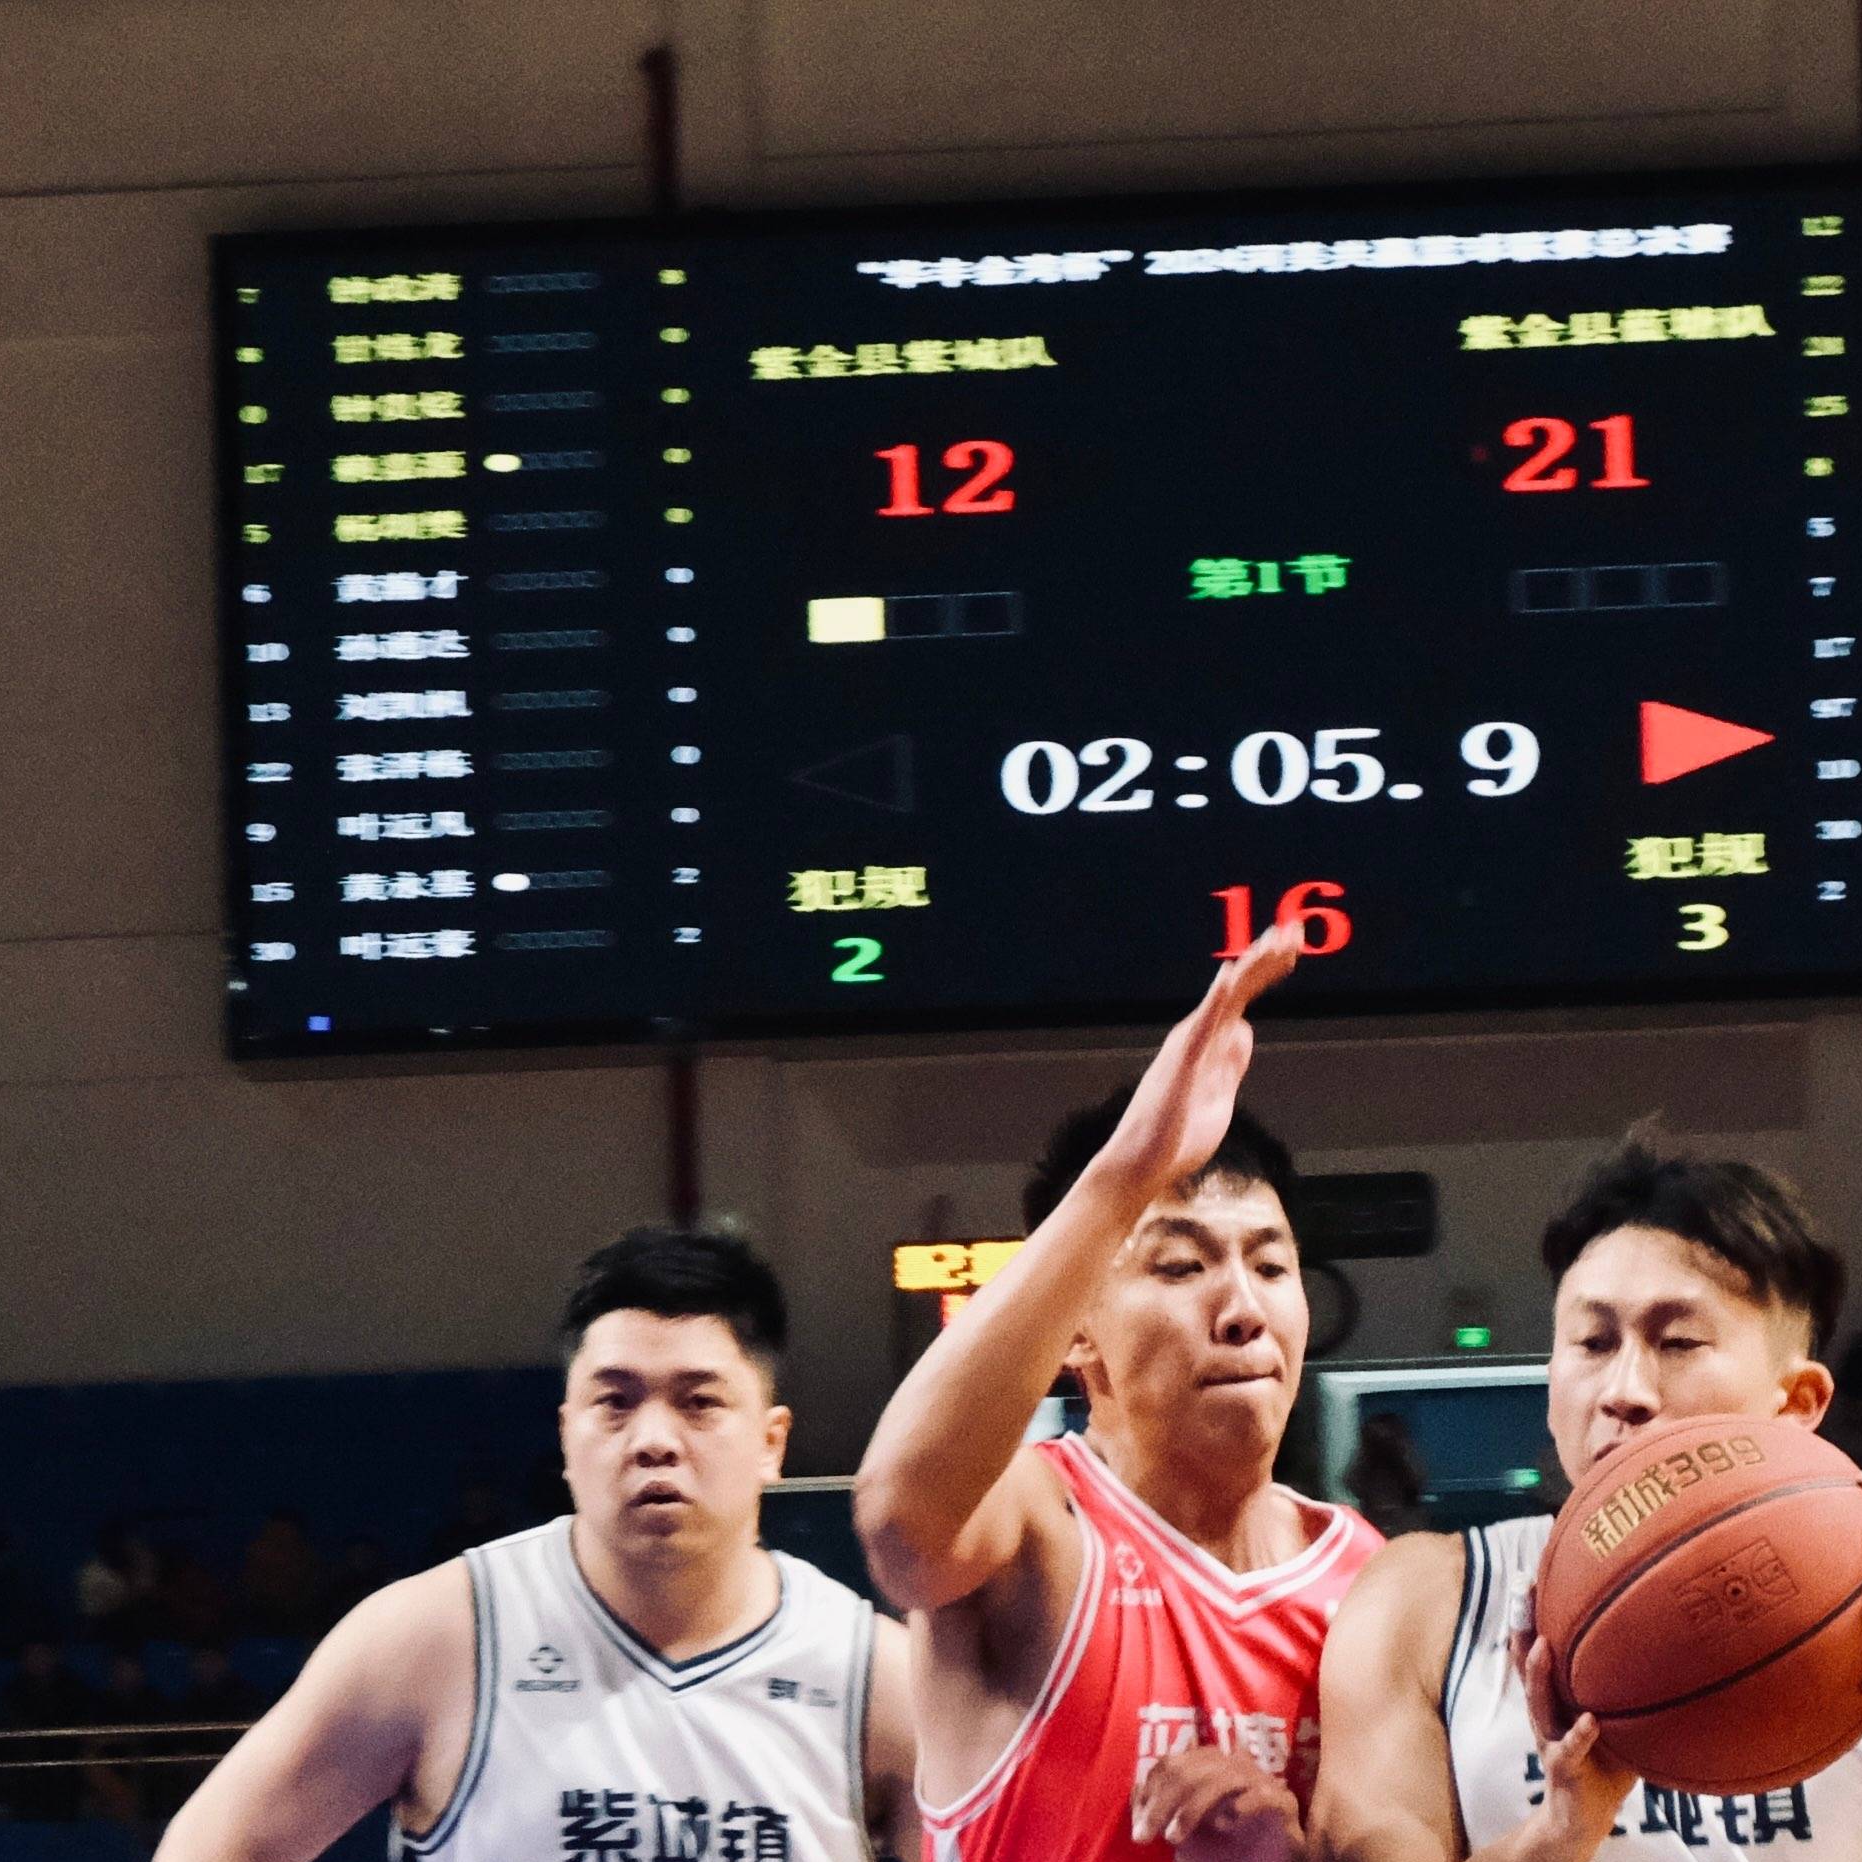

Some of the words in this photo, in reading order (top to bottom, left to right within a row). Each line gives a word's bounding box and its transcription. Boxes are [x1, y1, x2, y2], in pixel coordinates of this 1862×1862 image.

[1502, 414, 1652, 493] 21
[874, 440, 1016, 518] 12
[1188, 554, 1352, 600] 第1节
[1624, 832, 1770, 880] 犯规
[787, 865, 931, 913] 犯规
[1210, 881, 1353, 960] 16
[1677, 903, 1730, 951] 3
[830, 936, 886, 983] 2
[1581, 1435, 1766, 1562] 新城399
